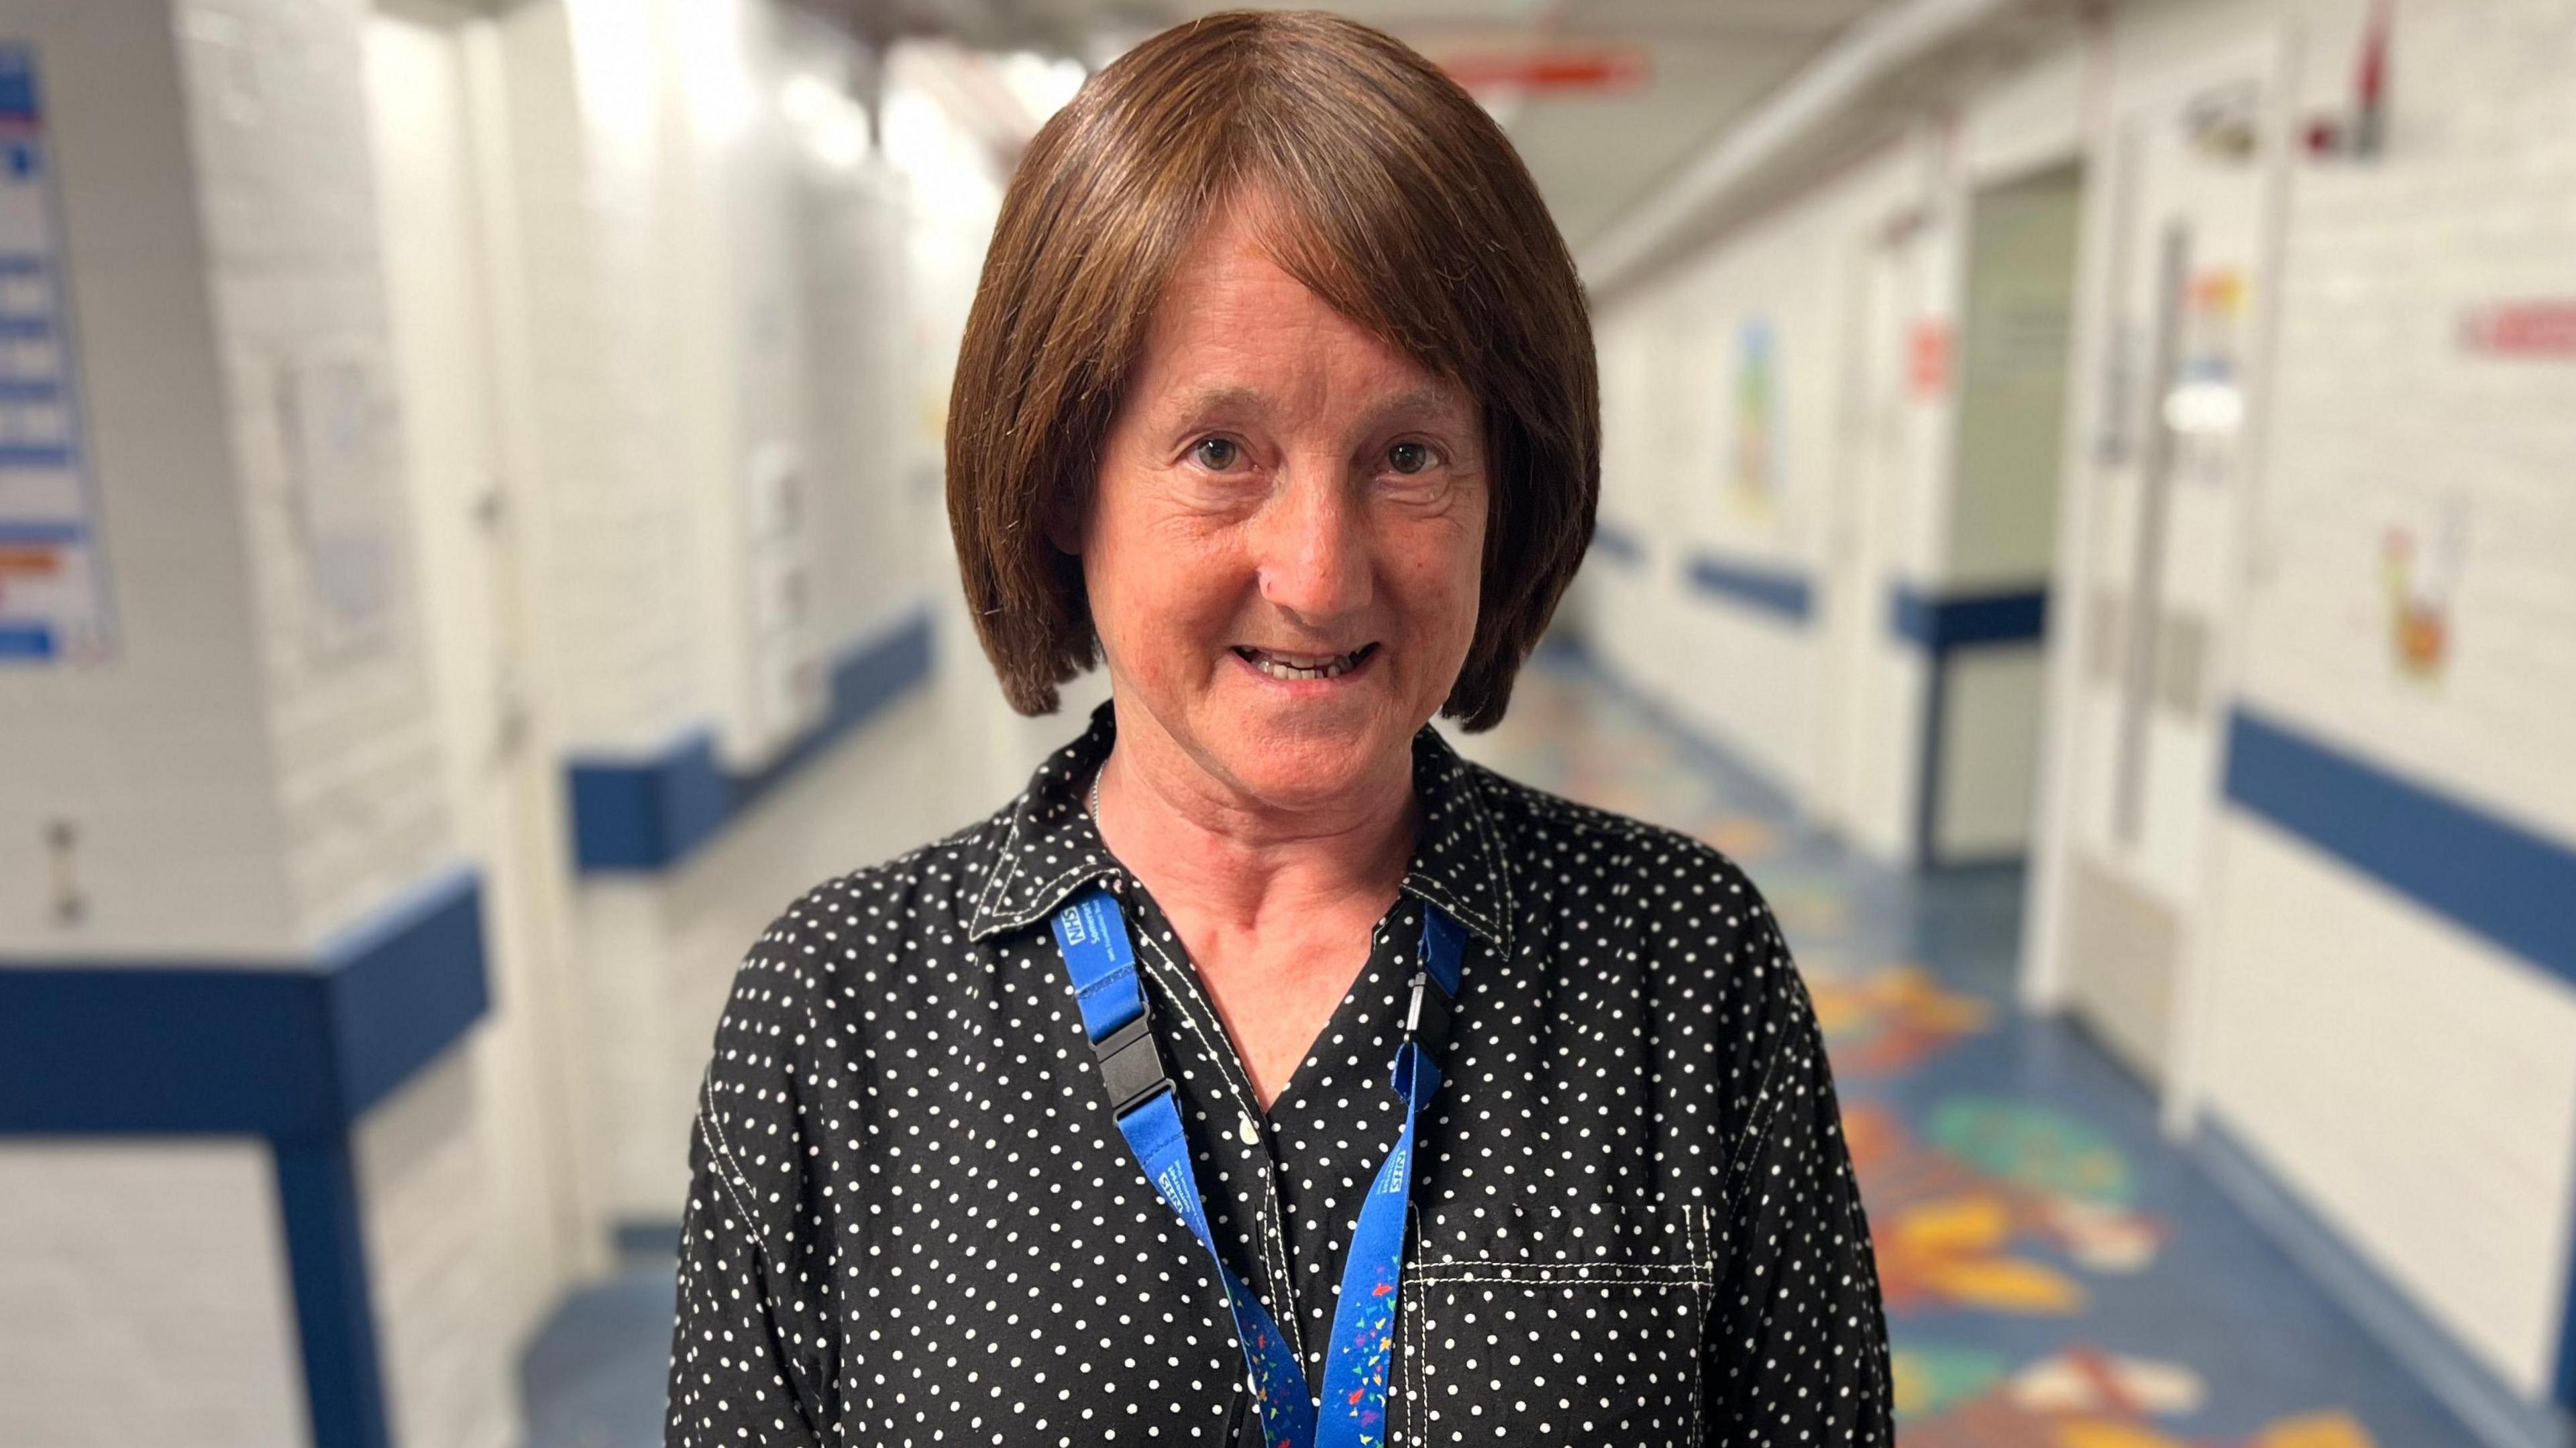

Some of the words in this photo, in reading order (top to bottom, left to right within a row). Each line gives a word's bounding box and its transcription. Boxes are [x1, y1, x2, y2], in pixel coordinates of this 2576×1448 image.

[1061, 909, 1083, 940] NHS
[1081, 901, 1101, 944] Somerset
[1391, 1156, 1403, 1189] NHS
[1159, 1176, 1181, 1210] NHS
